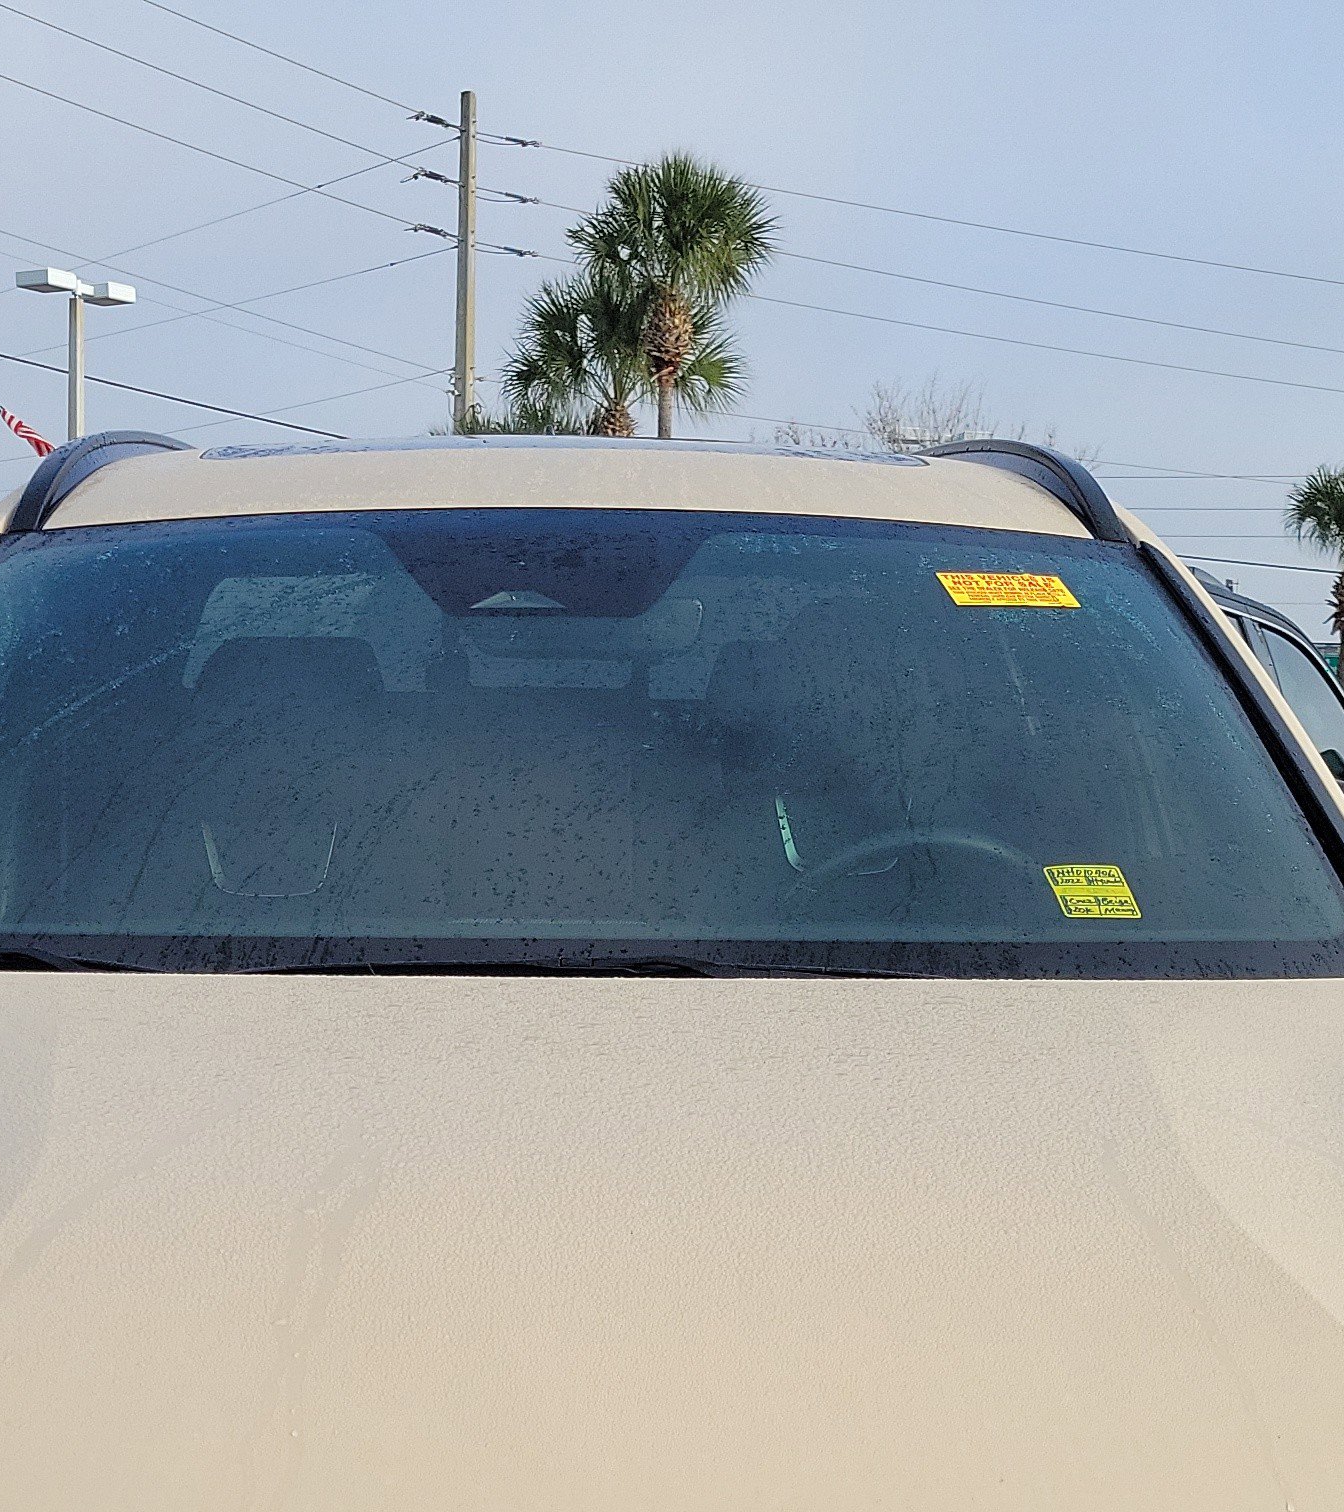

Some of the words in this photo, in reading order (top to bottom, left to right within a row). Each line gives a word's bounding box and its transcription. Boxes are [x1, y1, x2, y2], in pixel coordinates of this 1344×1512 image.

[940, 574, 974, 582] THIS
[977, 574, 1037, 583] VEHICLE
[1018, 581, 1054, 589] SALE
